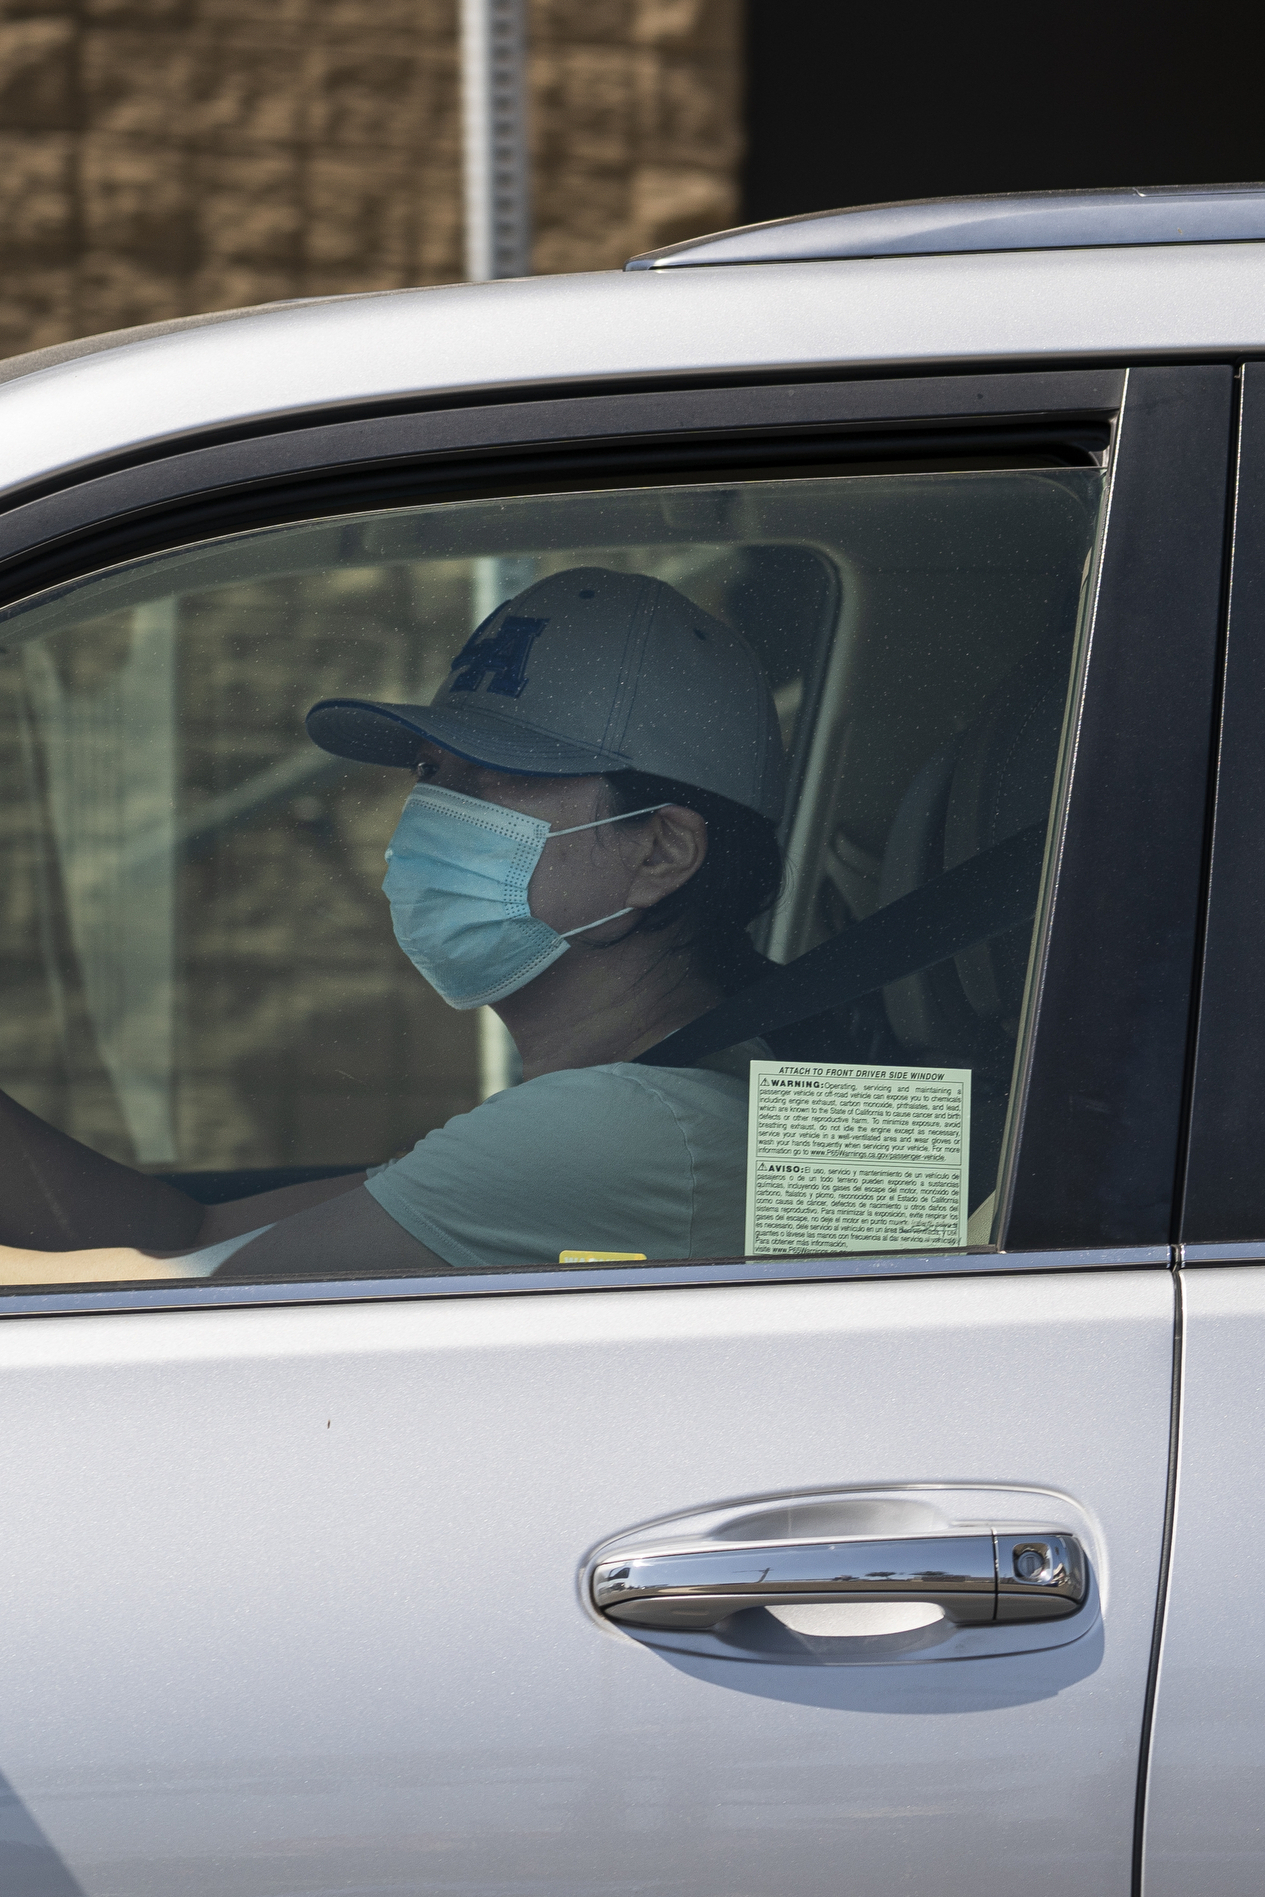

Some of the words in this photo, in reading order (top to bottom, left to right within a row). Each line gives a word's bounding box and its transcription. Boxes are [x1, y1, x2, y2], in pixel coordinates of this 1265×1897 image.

[779, 1066, 810, 1074] ATTACH
[826, 1068, 854, 1076] FRONT
[856, 1069, 886, 1077] DRIVER
[911, 1072, 944, 1080] WINDOW
